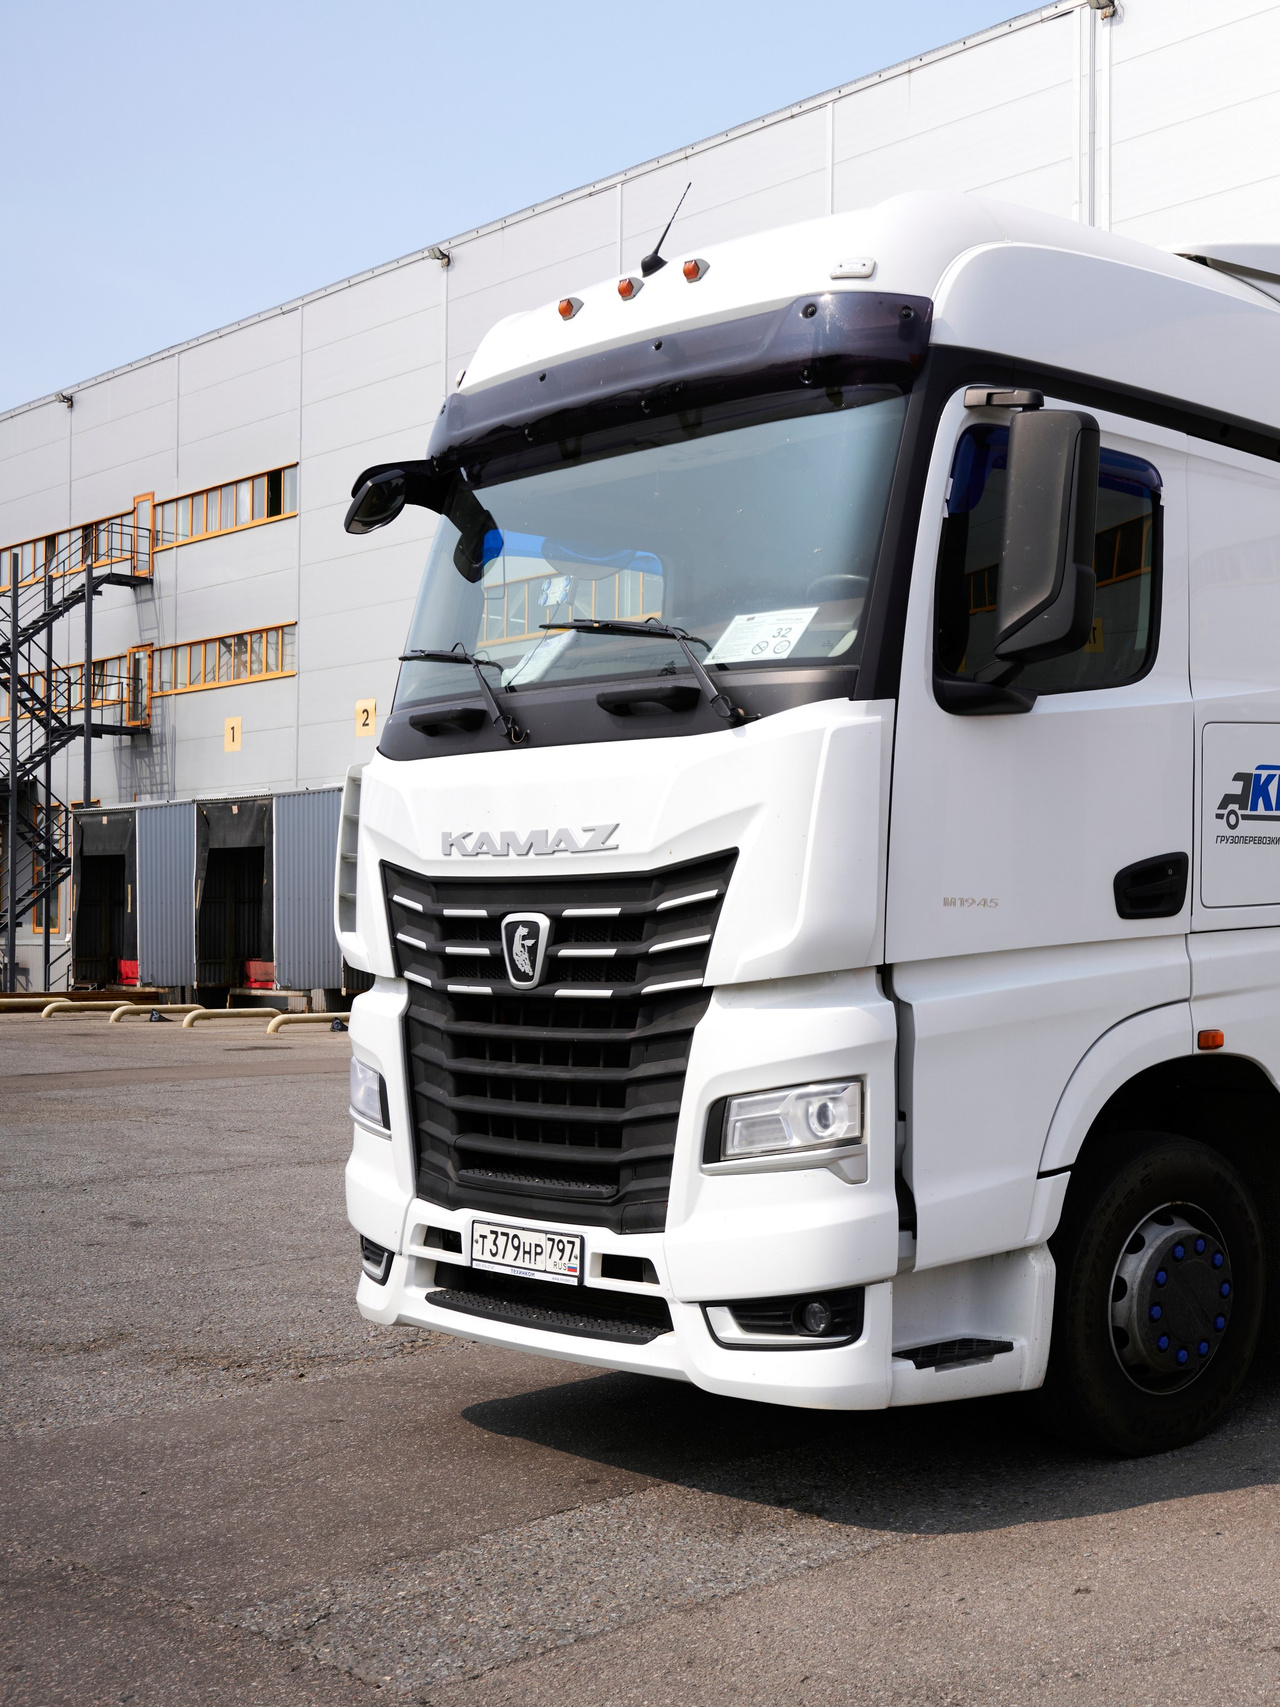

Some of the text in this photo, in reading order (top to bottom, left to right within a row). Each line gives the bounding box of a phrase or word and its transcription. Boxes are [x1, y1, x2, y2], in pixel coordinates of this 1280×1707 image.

[772, 627, 792, 638] 32
[361, 708, 370, 727] 2
[230, 726, 236, 743] 1
[441, 823, 621, 857] KAMAZ
[1216, 835, 1280, 845] ГРУЗОПЕРЕВОЗКИ
[547, 1237, 575, 1262] 797
[553, 1261, 567, 1271] RUS
